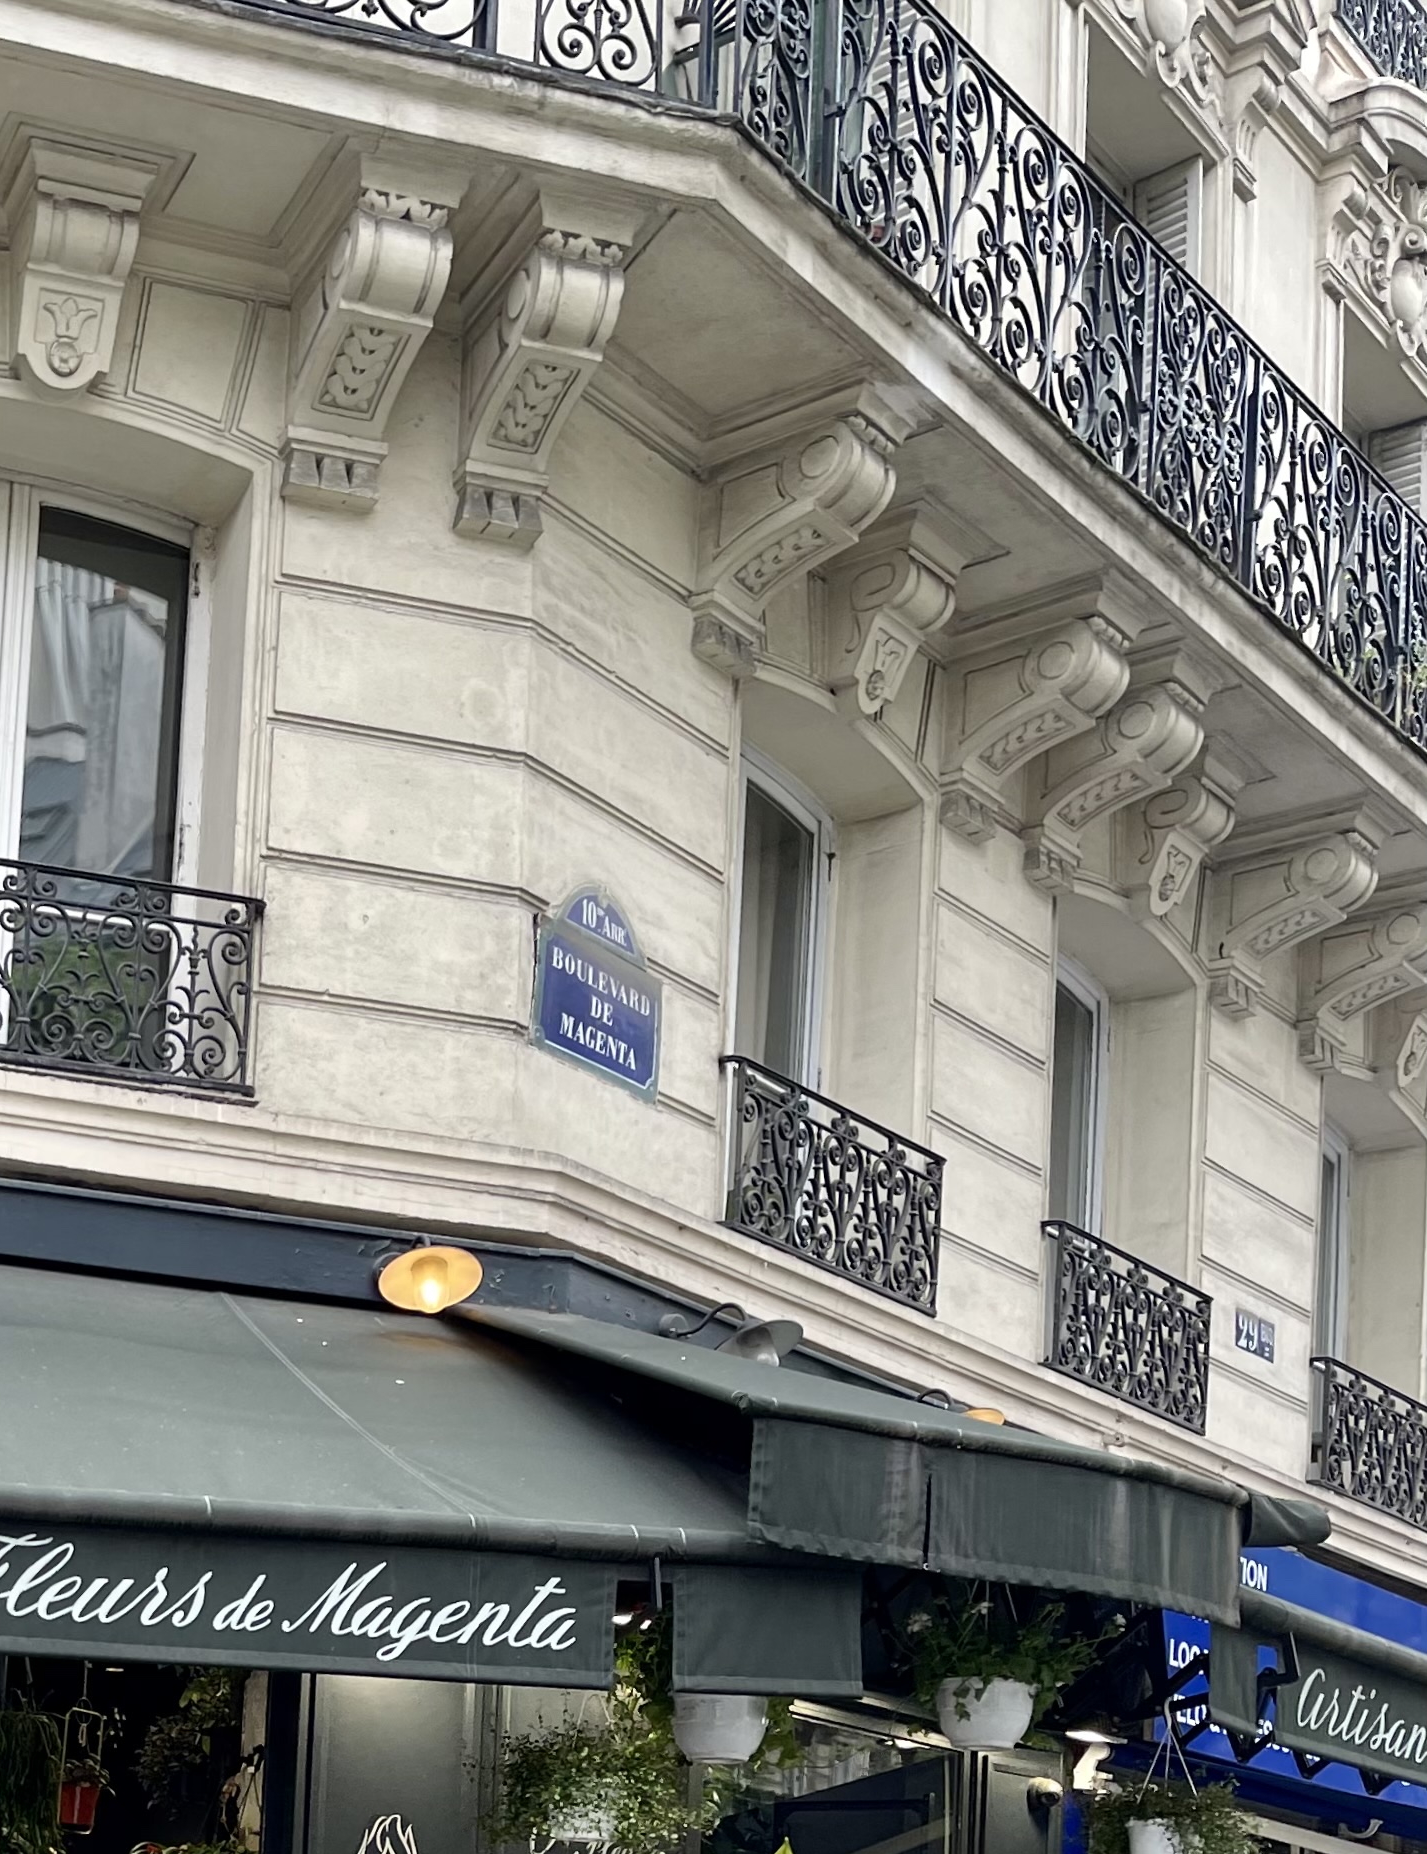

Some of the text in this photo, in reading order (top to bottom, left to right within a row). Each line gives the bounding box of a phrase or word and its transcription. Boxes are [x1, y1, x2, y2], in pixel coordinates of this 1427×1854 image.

[552, 946, 651, 1017] BOULEVARD
[590, 994, 613, 1027] DE
[559, 1012, 636, 1071] MAGENTA
[212, 1574, 275, 1632] de
[281, 1561, 577, 1662] Magenta
[1297, 1668, 1427, 1763] Artisan
